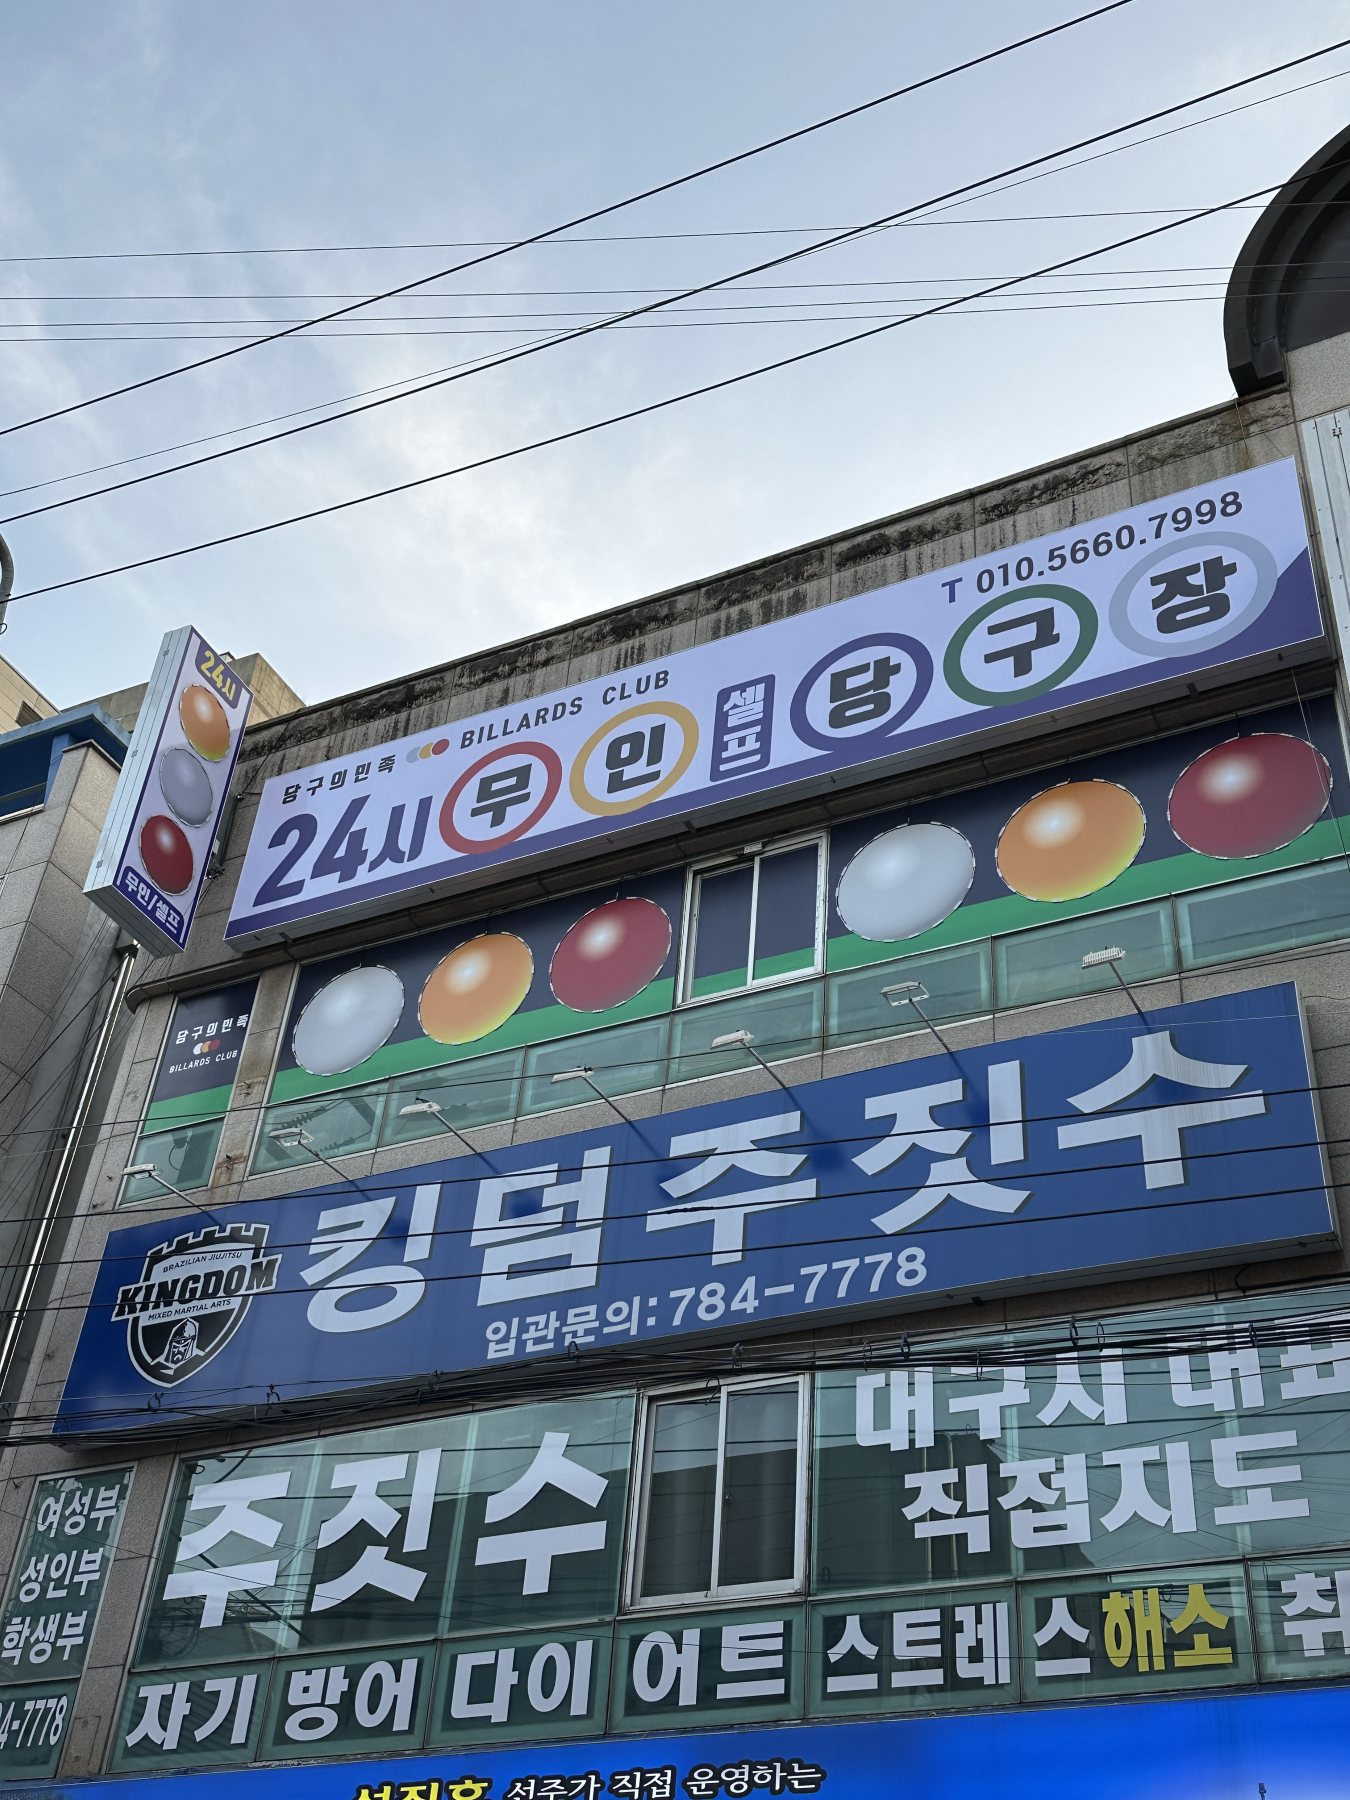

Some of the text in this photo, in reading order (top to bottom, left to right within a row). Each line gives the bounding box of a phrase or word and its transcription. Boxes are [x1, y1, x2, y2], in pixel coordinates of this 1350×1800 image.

[941, 491, 1243, 603] T 010.5660.7998
[200, 650, 235, 701] 24시
[460, 670, 670, 750] BILLARDS CLUB
[252, 793, 433, 907] 24시
[719, 682, 766, 772] 셀프
[168, 1050, 238, 1074] BILLARDS CLUB
[114, 1258, 279, 1318] KINGDOM
[162, 1251, 243, 1273] BRAZILIAN JIUJITSU
[147, 1298, 231, 1321] MIXED MARTIAL ARTS
[856, 1346, 1128, 1452] 대구시
[37, 1484, 121, 1538] 여성부
[162, 1431, 609, 1629] 주짓수
[19, 1547, 104, 1603] 성인부
[0, 1610, 88, 1666] 학생부
[1102, 1582, 1234, 1672] 해소
[0, 1695, 68, 1750] 4-7778
[612, 1769, 672, 1800] 직접
[686, 1762, 823, 1795] 운영하는
